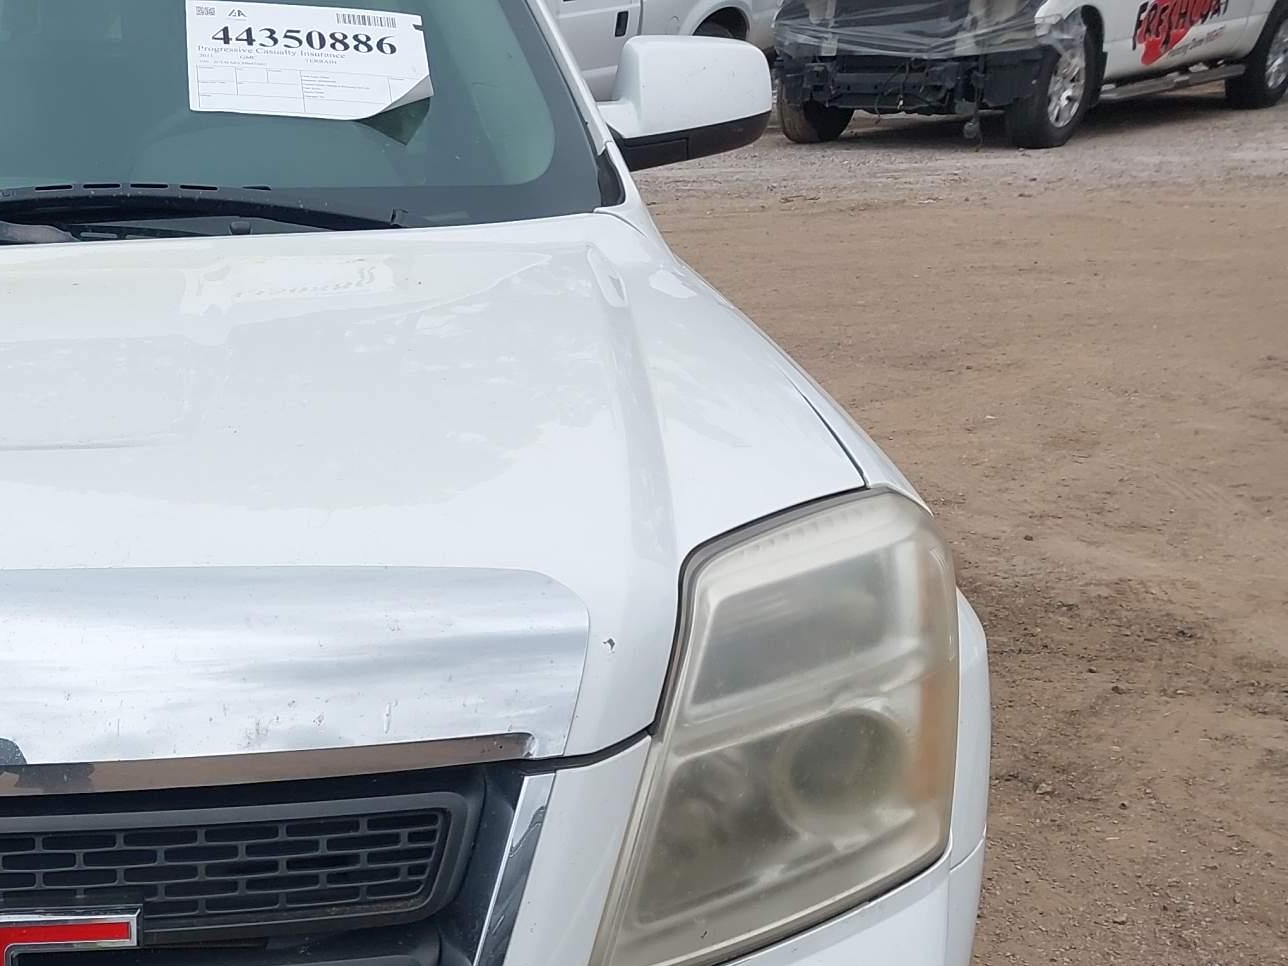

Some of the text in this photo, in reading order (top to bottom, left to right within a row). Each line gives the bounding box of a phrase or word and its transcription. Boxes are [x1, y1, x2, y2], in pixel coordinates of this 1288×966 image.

[211, 25, 397, 55] 44350886
[198, 45, 346, 59] Progressive Casualty Insurance
